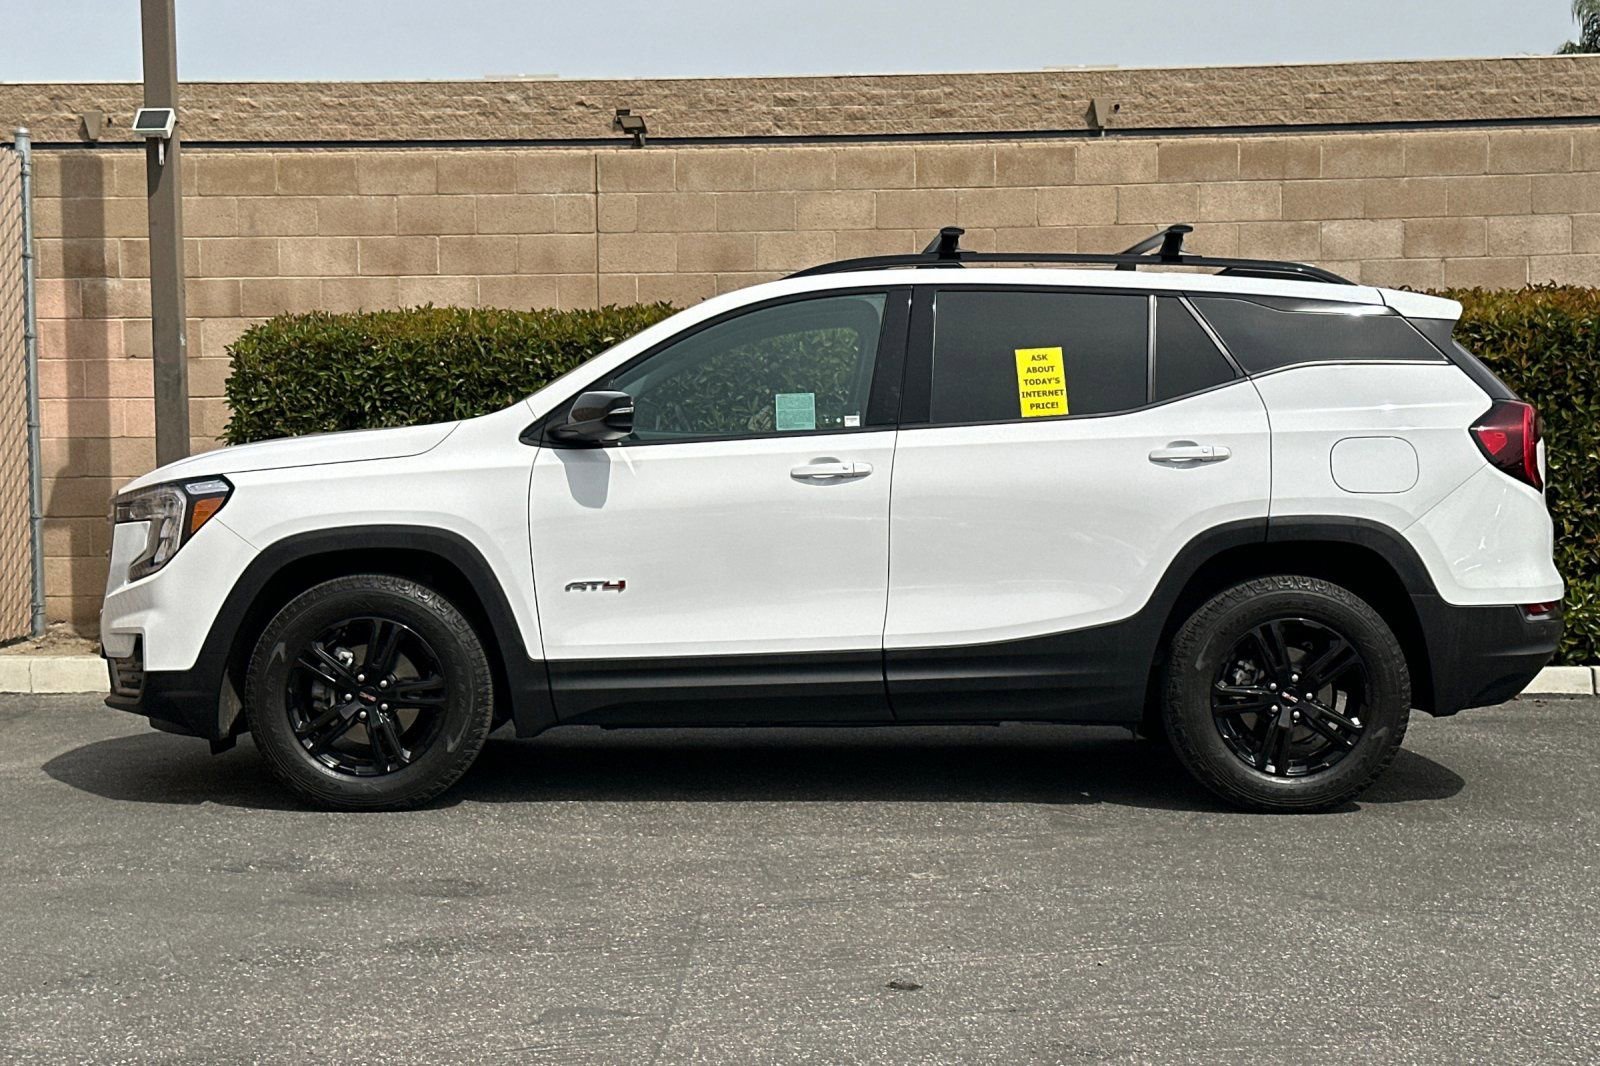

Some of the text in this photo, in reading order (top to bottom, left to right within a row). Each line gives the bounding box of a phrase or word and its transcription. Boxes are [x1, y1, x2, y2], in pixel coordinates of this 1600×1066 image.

[1023, 377, 1060, 386] TODAY'S
[1021, 389, 1064, 398] INTERNET
[1030, 402, 1059, 410] PRICE!
[564, 580, 626, 592] AT4
